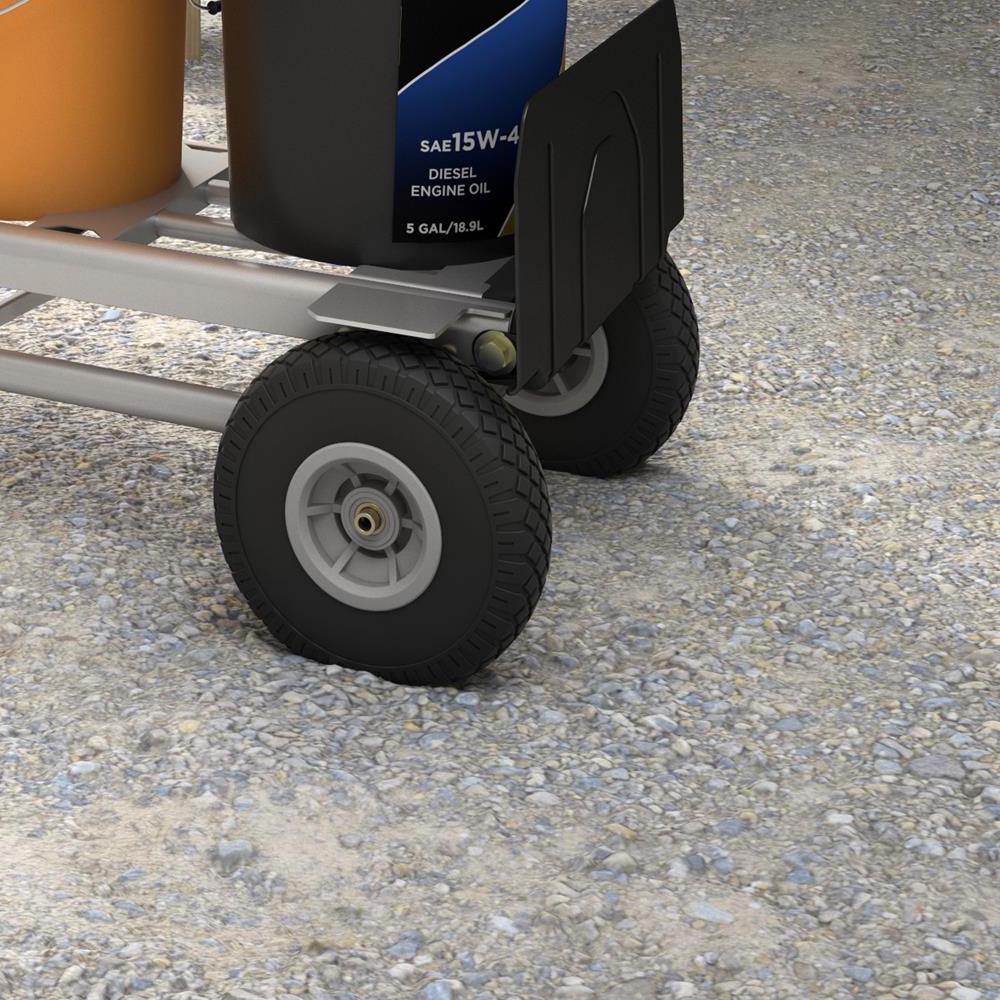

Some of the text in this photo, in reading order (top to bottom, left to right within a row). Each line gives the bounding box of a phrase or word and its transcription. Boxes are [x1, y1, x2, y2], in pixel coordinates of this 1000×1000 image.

[420, 140, 452, 153] SAE
[428, 167, 477, 180] DIESEL
[410, 182, 491, 197] ENGINE OIL
[406, 220, 484, 235] 5 GAL/18.9L
